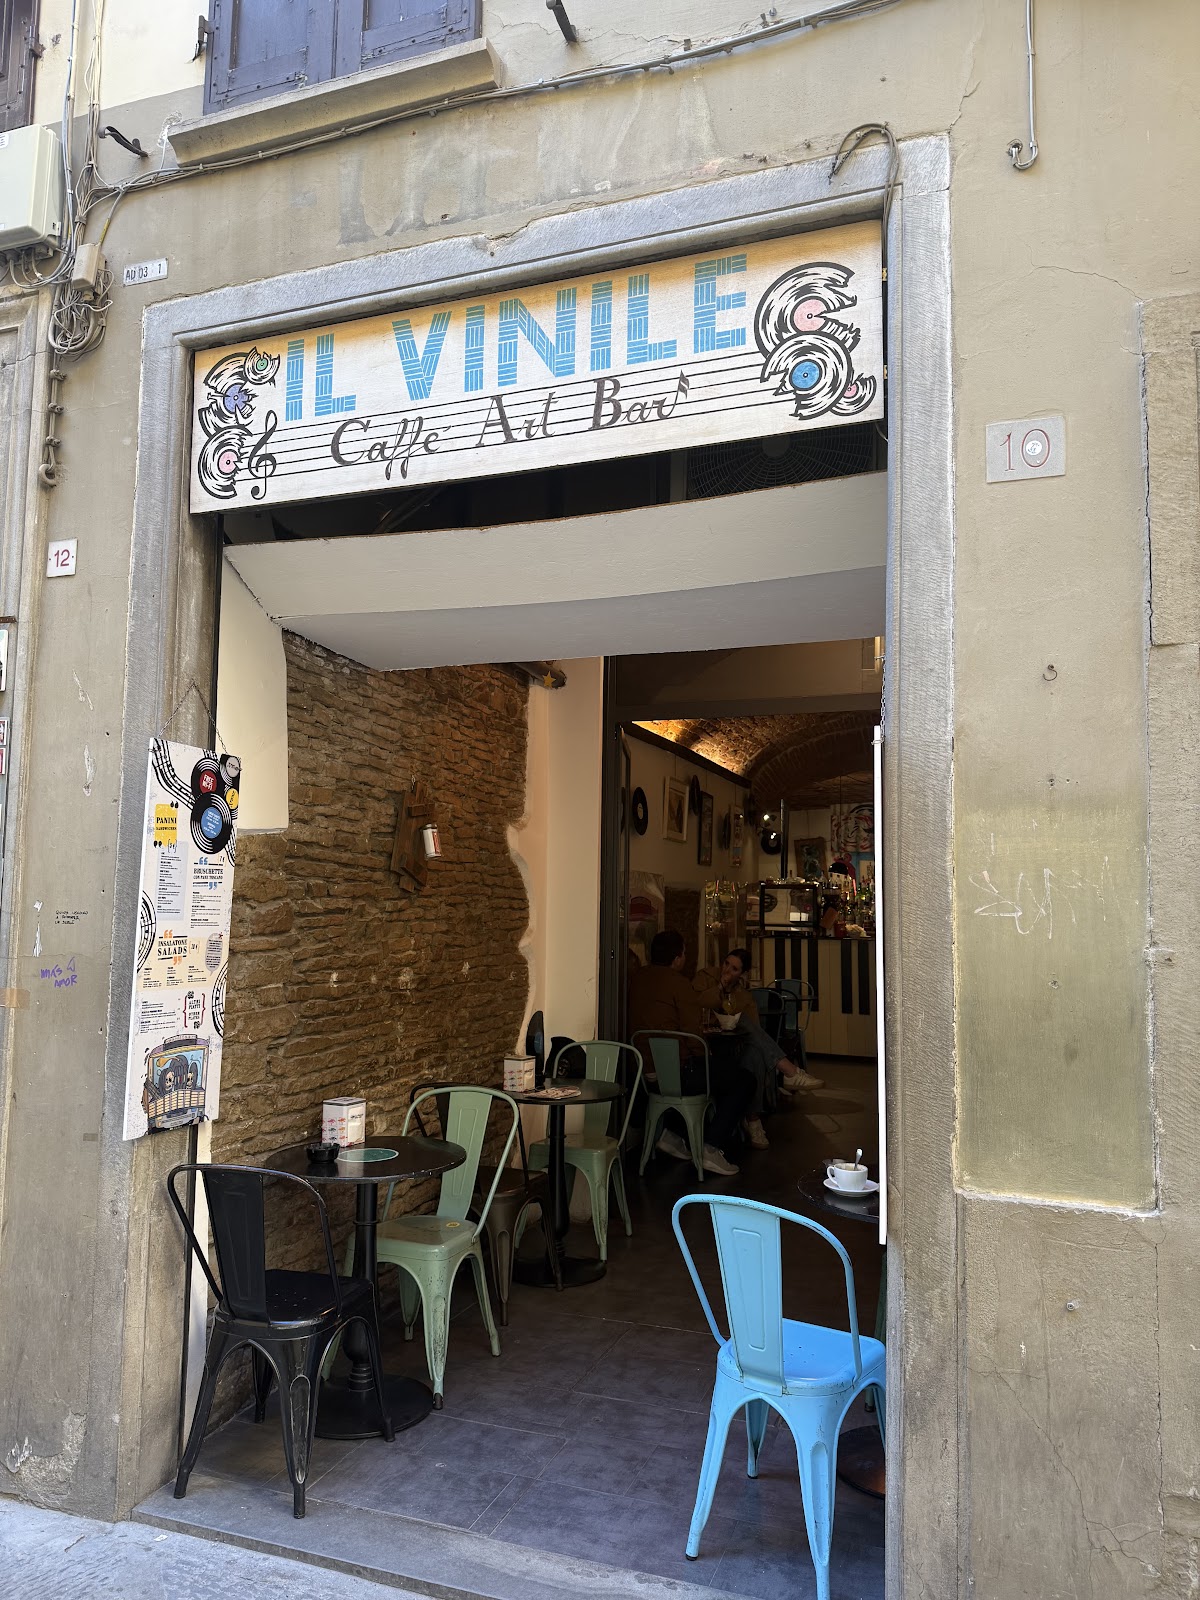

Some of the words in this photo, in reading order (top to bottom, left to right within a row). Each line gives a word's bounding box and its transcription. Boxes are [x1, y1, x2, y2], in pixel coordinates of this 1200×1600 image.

[285, 333, 356, 421] IL
[392, 253, 747, 401] VINILE
[475, 391, 559, 448] Art
[588, 377, 678, 431] Bar
[1000, 428, 1051, 471] 10
[54, 549, 70, 568] 12
[156, 816, 177, 824] PANINI
[158, 938, 187, 947] INSALATONE
[157, 946, 187, 956] SALADS
[54, 974, 78, 988] AMOR
